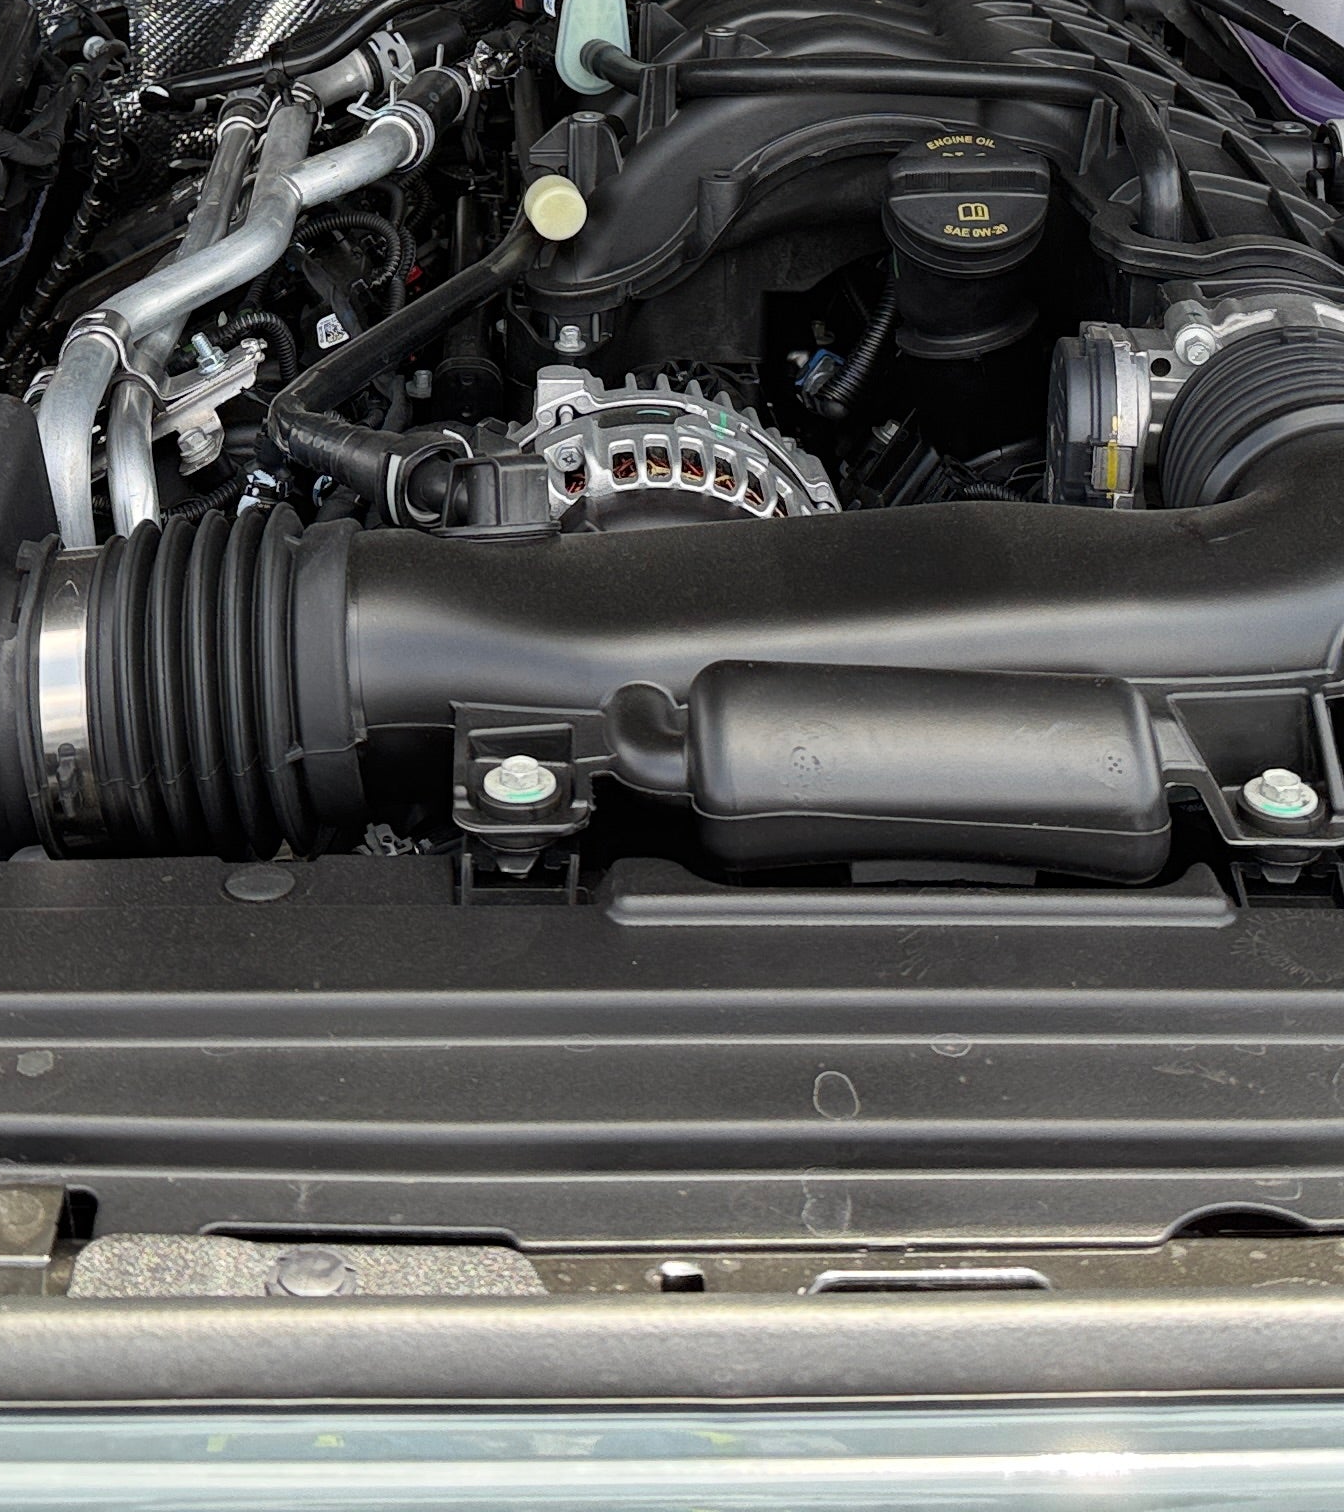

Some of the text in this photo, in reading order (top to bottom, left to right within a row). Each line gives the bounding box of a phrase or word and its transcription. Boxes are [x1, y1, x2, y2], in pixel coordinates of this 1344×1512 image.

[926, 135, 996, 150] ENGINE OIL
[943, 223, 1009, 238] SAE 0W-20
